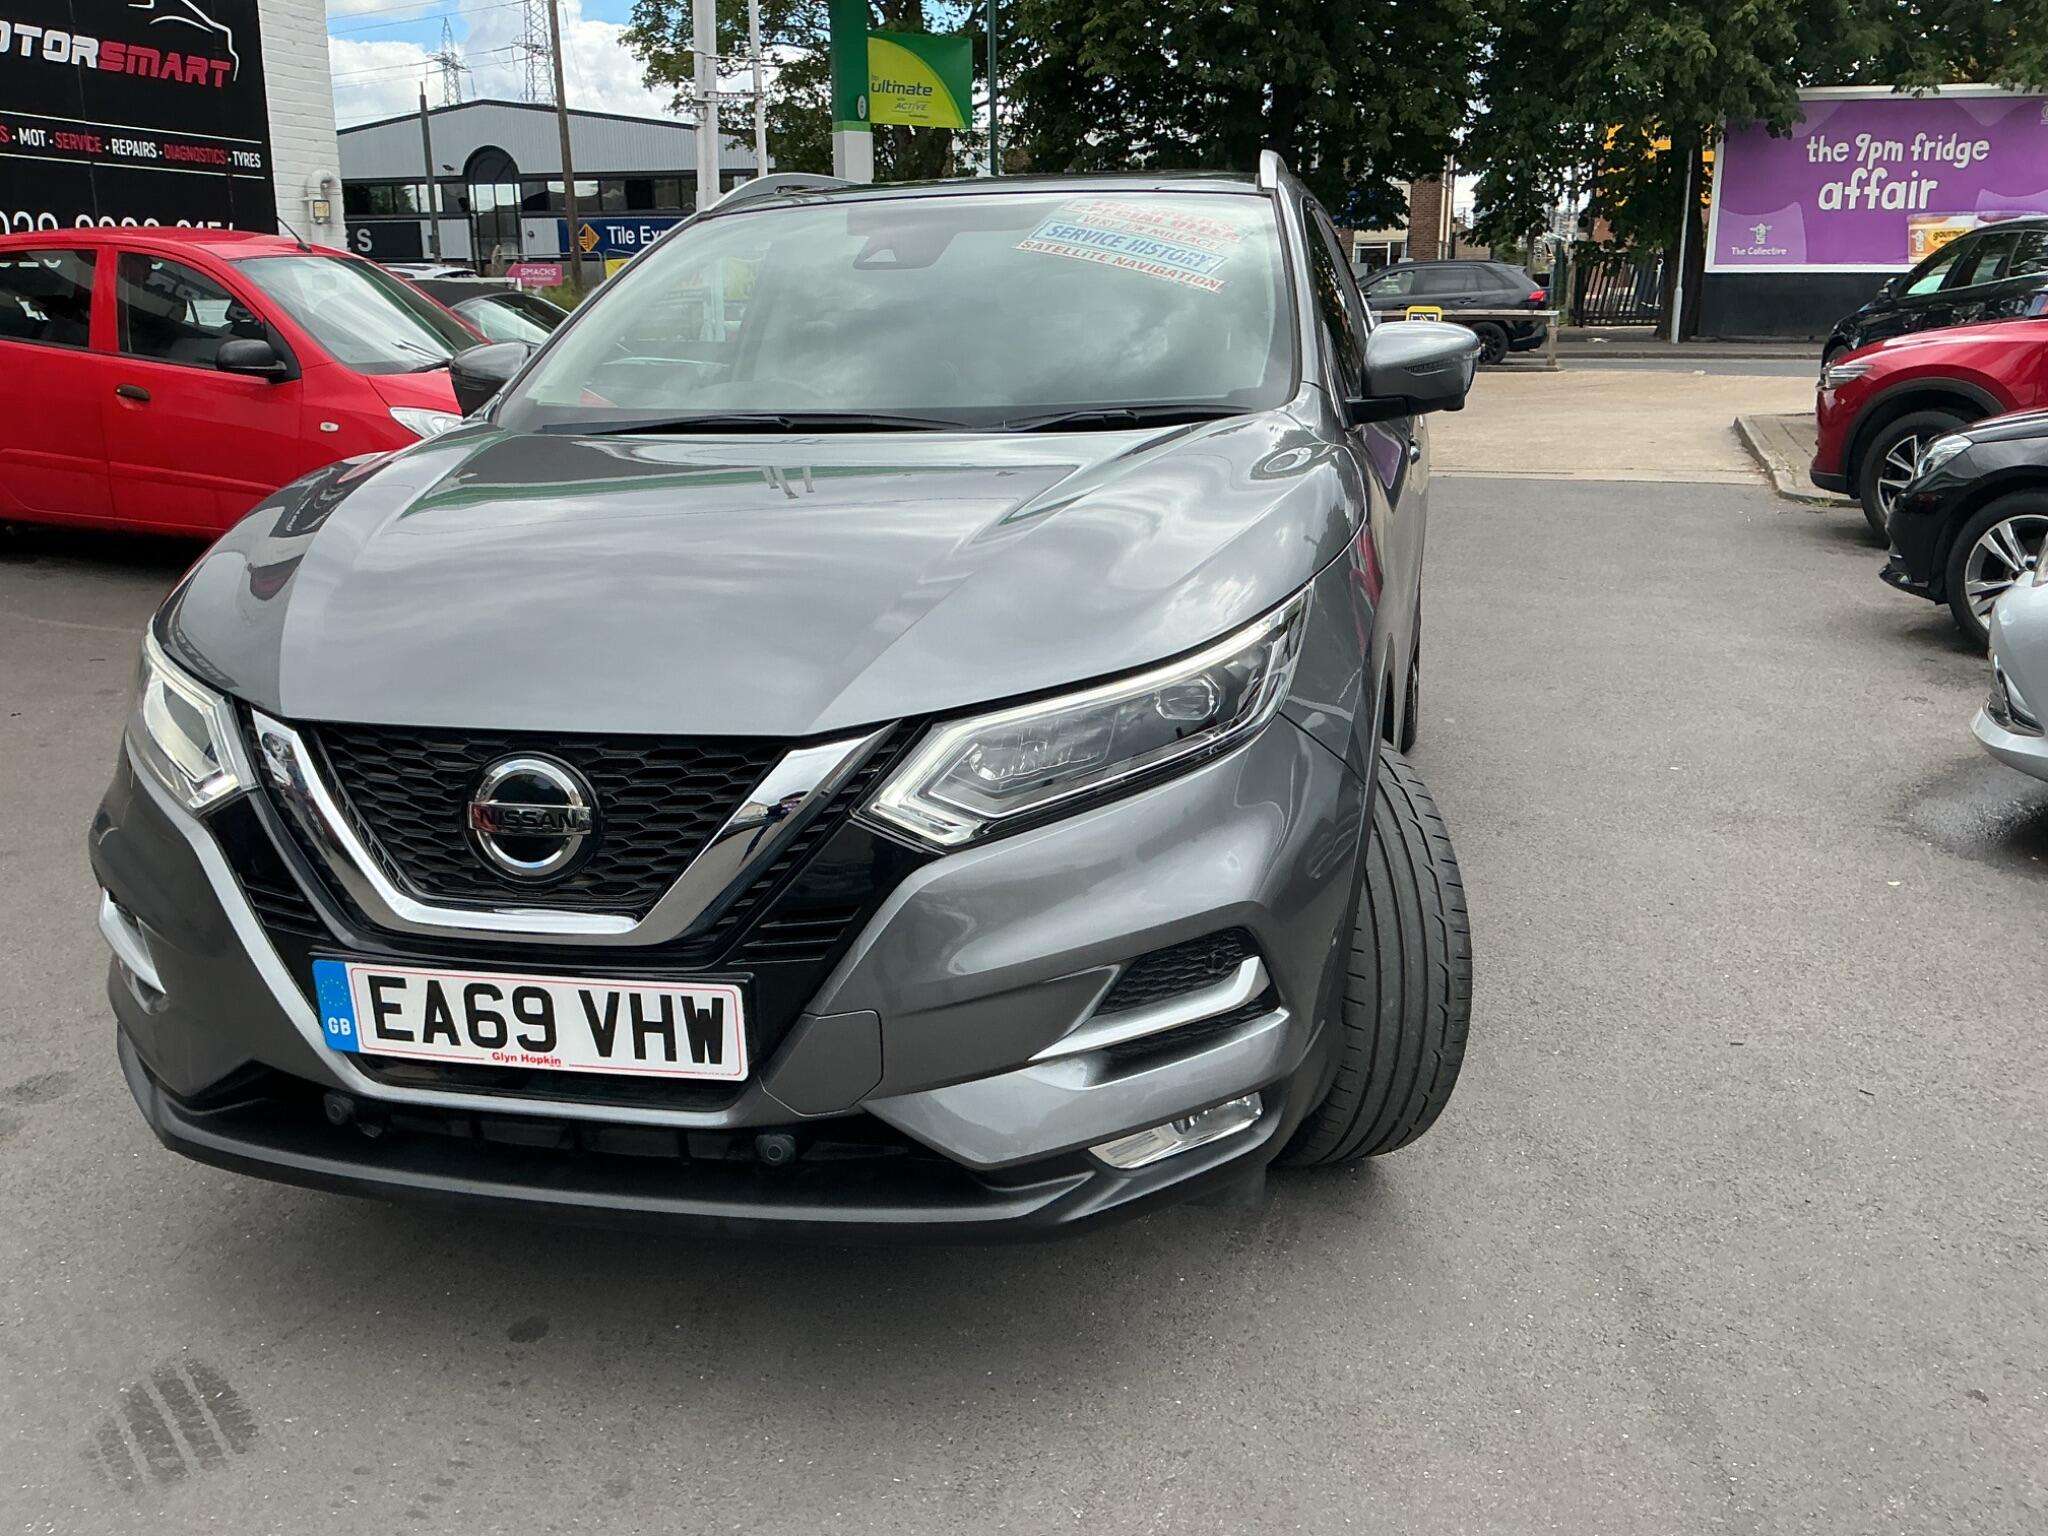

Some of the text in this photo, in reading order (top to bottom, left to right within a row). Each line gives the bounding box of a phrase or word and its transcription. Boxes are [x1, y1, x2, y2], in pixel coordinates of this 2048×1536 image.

[871, 80, 933, 96] ultimate
[18, 127, 46, 147] MOT
[55, 132, 102, 153] SERVICE
[112, 138, 157, 158] REPAIRS
[164, 144, 227, 165] DIAGNOSTICS
[233, 151, 261, 169] TYRES
[1806, 131, 1990, 171] the 9pm fridge
[1818, 167, 1938, 210] affair
[606, 225, 635, 244] Tile
[1046, 225, 1215, 267] SERVICE HISTORY
[1731, 245, 1787, 255] The Collective
[1020, 241, 1220, 289] SATELLITE NAVIGATION
[328, 1017, 352, 1036] GB
[367, 974, 725, 1065] EA69 VHW
[492, 1052, 562, 1068] Glyn Hopkin
